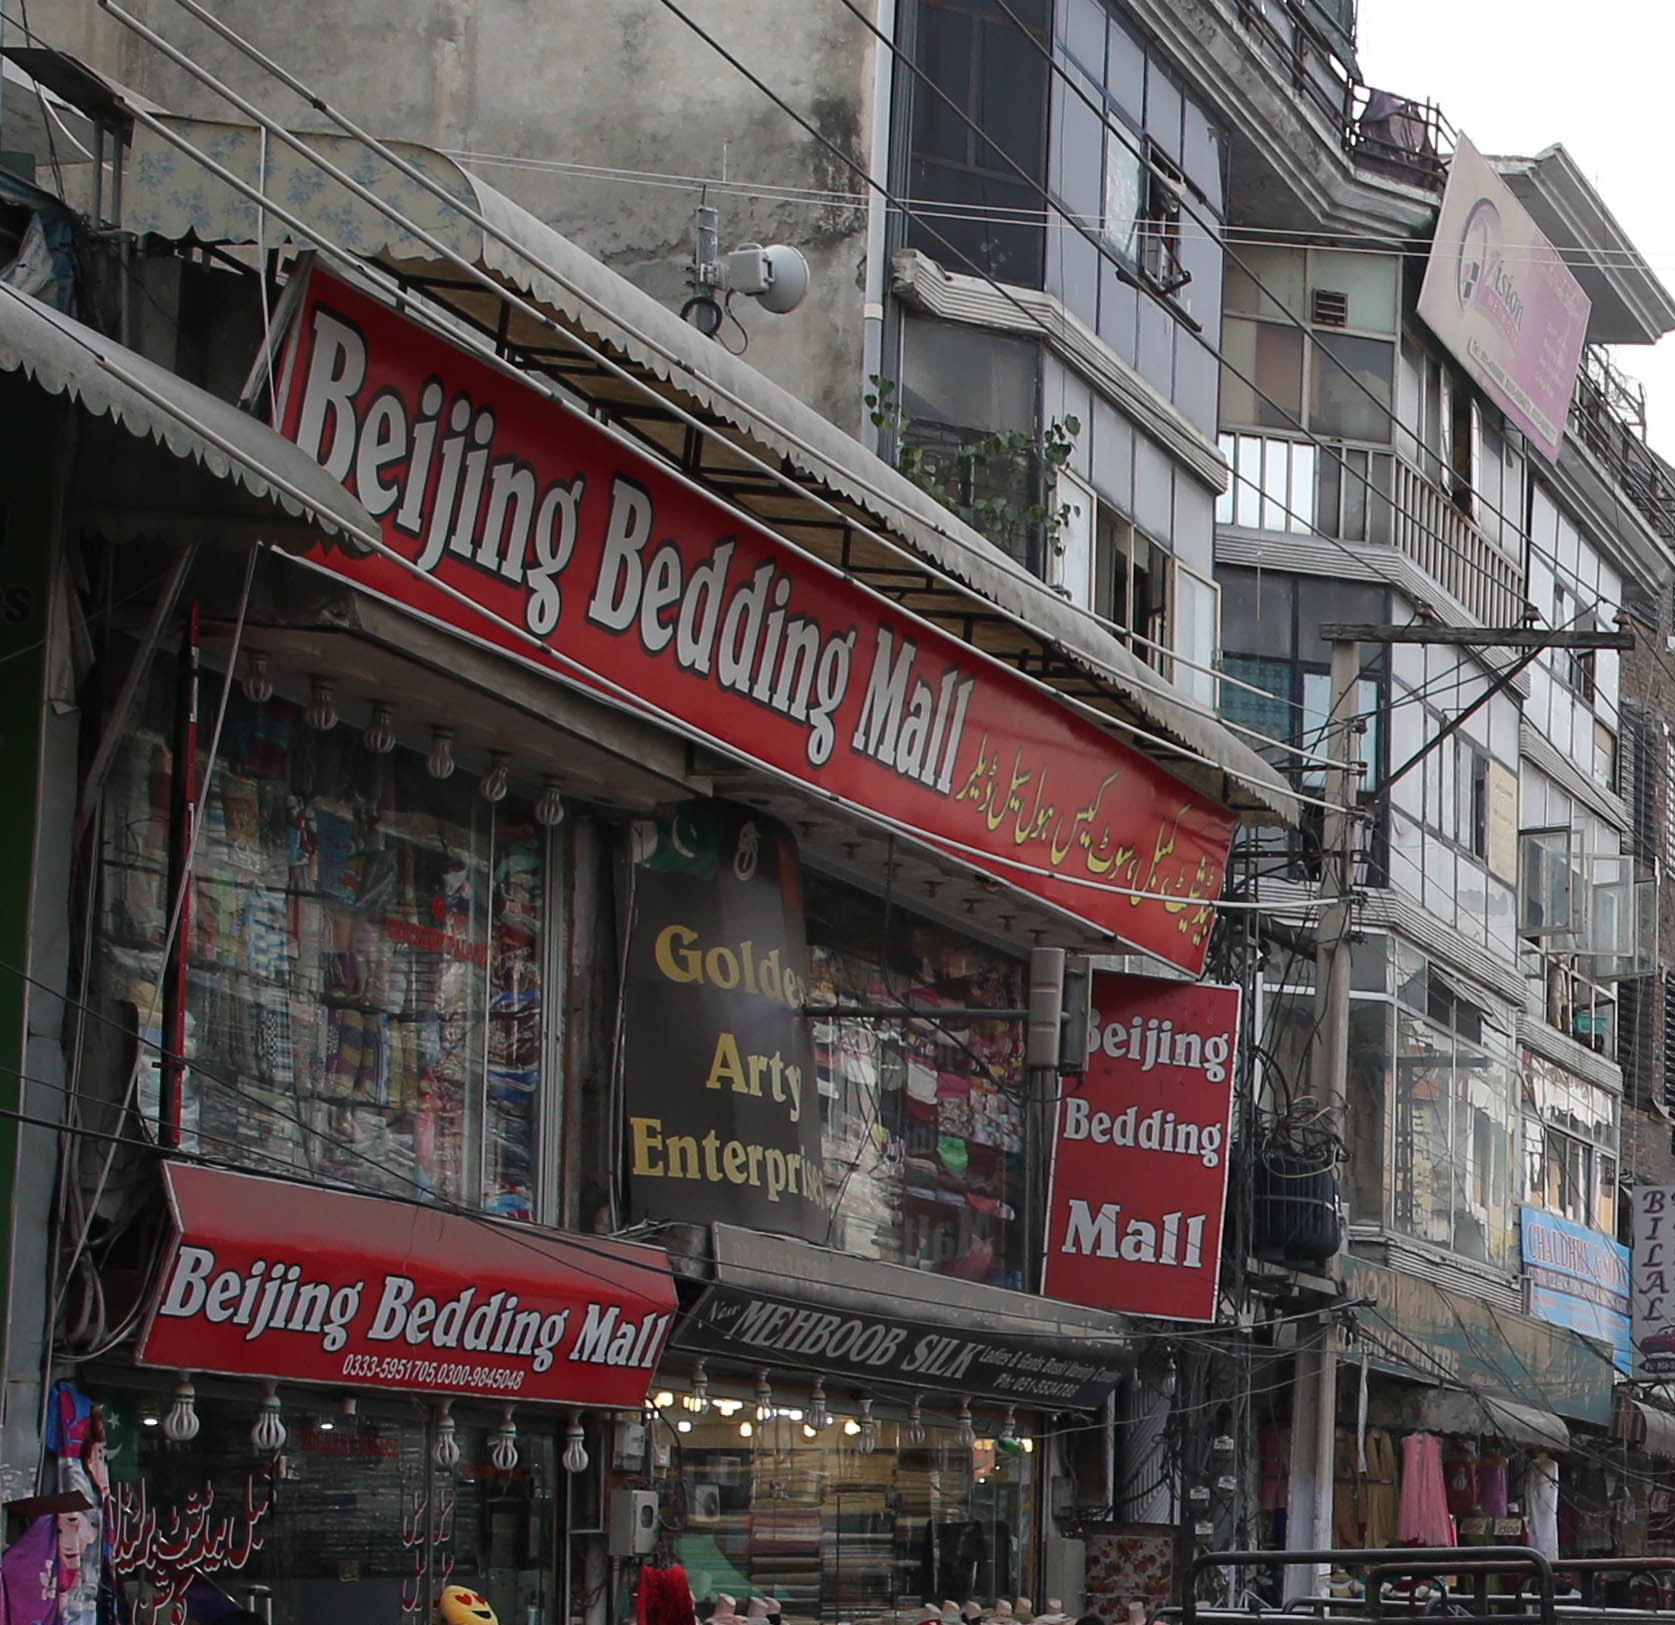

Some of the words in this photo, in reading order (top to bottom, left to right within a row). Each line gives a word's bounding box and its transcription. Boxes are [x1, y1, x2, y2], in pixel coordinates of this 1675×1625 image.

[297, 309, 585, 636] Beijing
[587, 478, 858, 766] Bedding
[852, 628, 974, 796] Mall
[705, 1033, 801, 1121] Arty
[1084, 1016, 1229, 1084] Beijing
[1062, 1098, 1223, 1169] Bedding
[1060, 1200, 1207, 1270] Mall
[1639, 1190, 1669, 1321] BILAL
[160, 1244, 364, 1352] Beijing
[366, 1273, 571, 1373] Bedding
[568, 1301, 670, 1371] Mall
[724, 1299, 909, 1368] MEHBOOB
[900, 1333, 986, 1380] SILK
